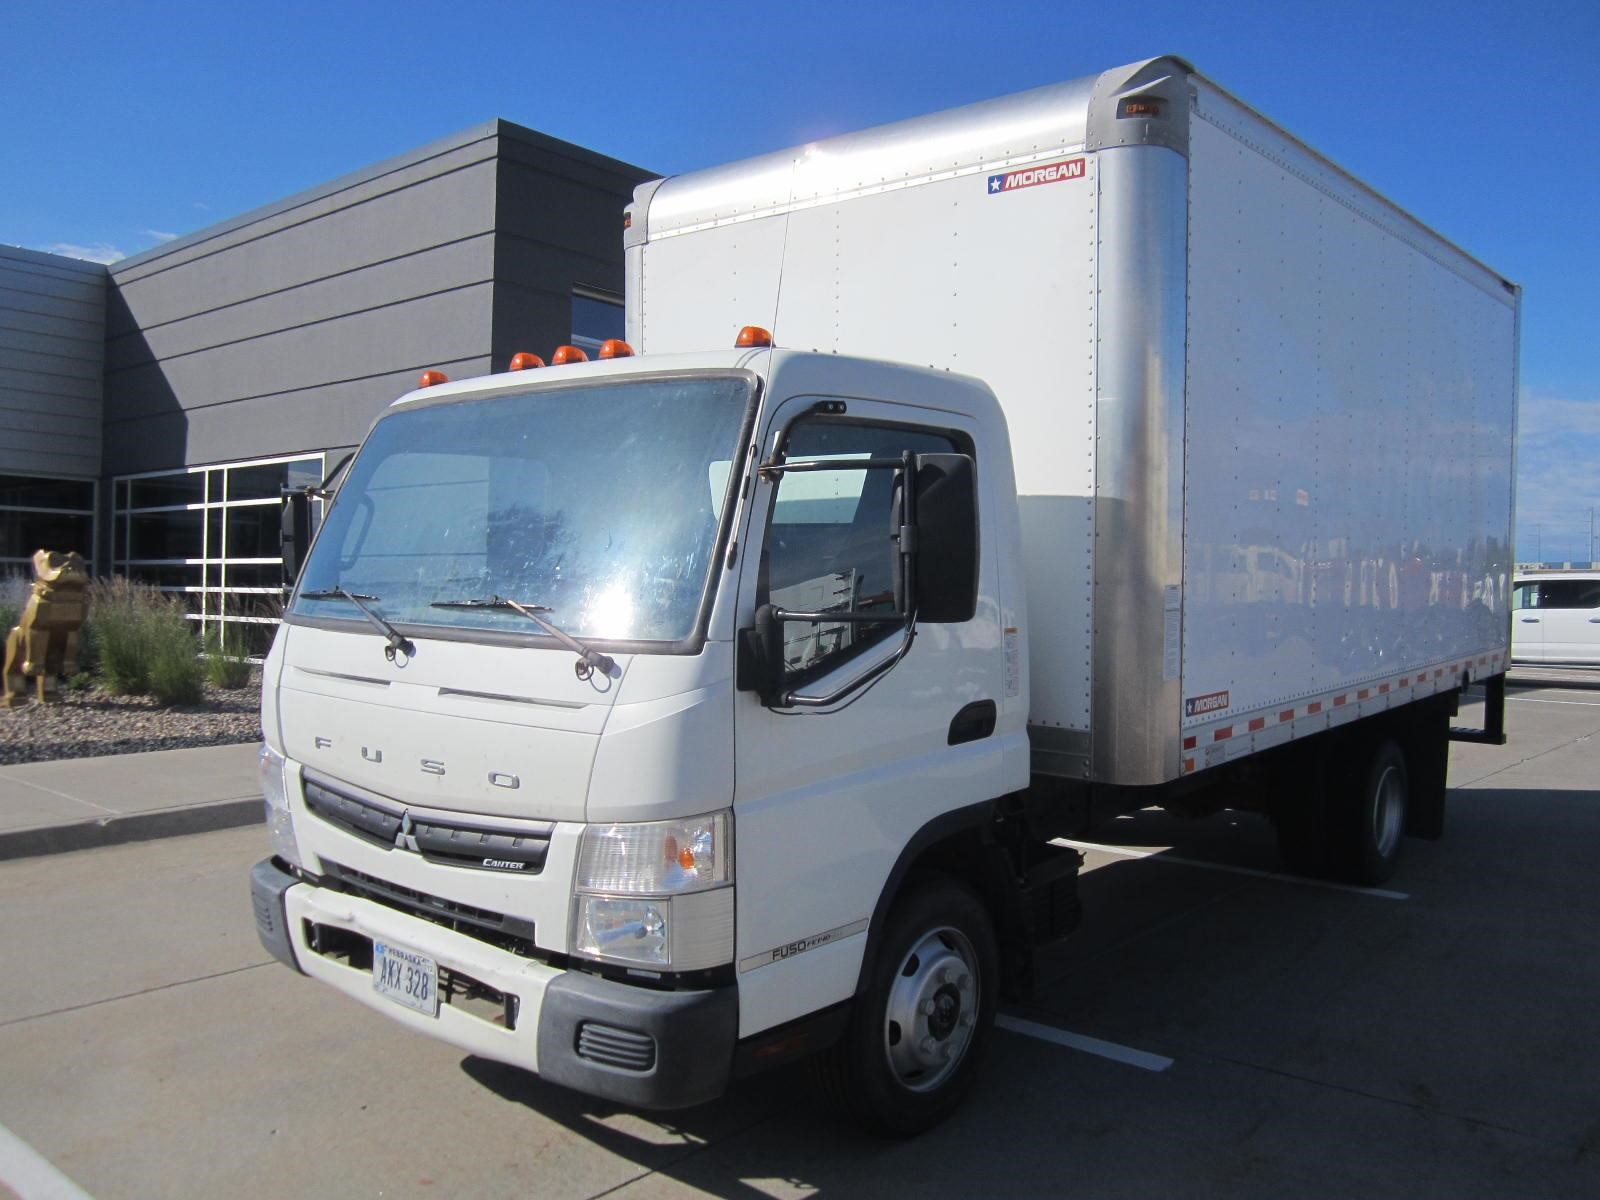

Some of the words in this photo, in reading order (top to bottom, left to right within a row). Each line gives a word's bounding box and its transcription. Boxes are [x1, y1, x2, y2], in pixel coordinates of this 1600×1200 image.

[1005, 161, 1081, 189] MORGAN
[1194, 693, 1229, 713] MORGAN
[315, 736, 520, 790] FUSO
[482, 858, 525, 870] CANTER
[389, 948, 422, 966] NEBRASKA
[772, 940, 806, 961] FUSO
[380, 956, 402, 991] AKX
[405, 966, 429, 1001] 328
